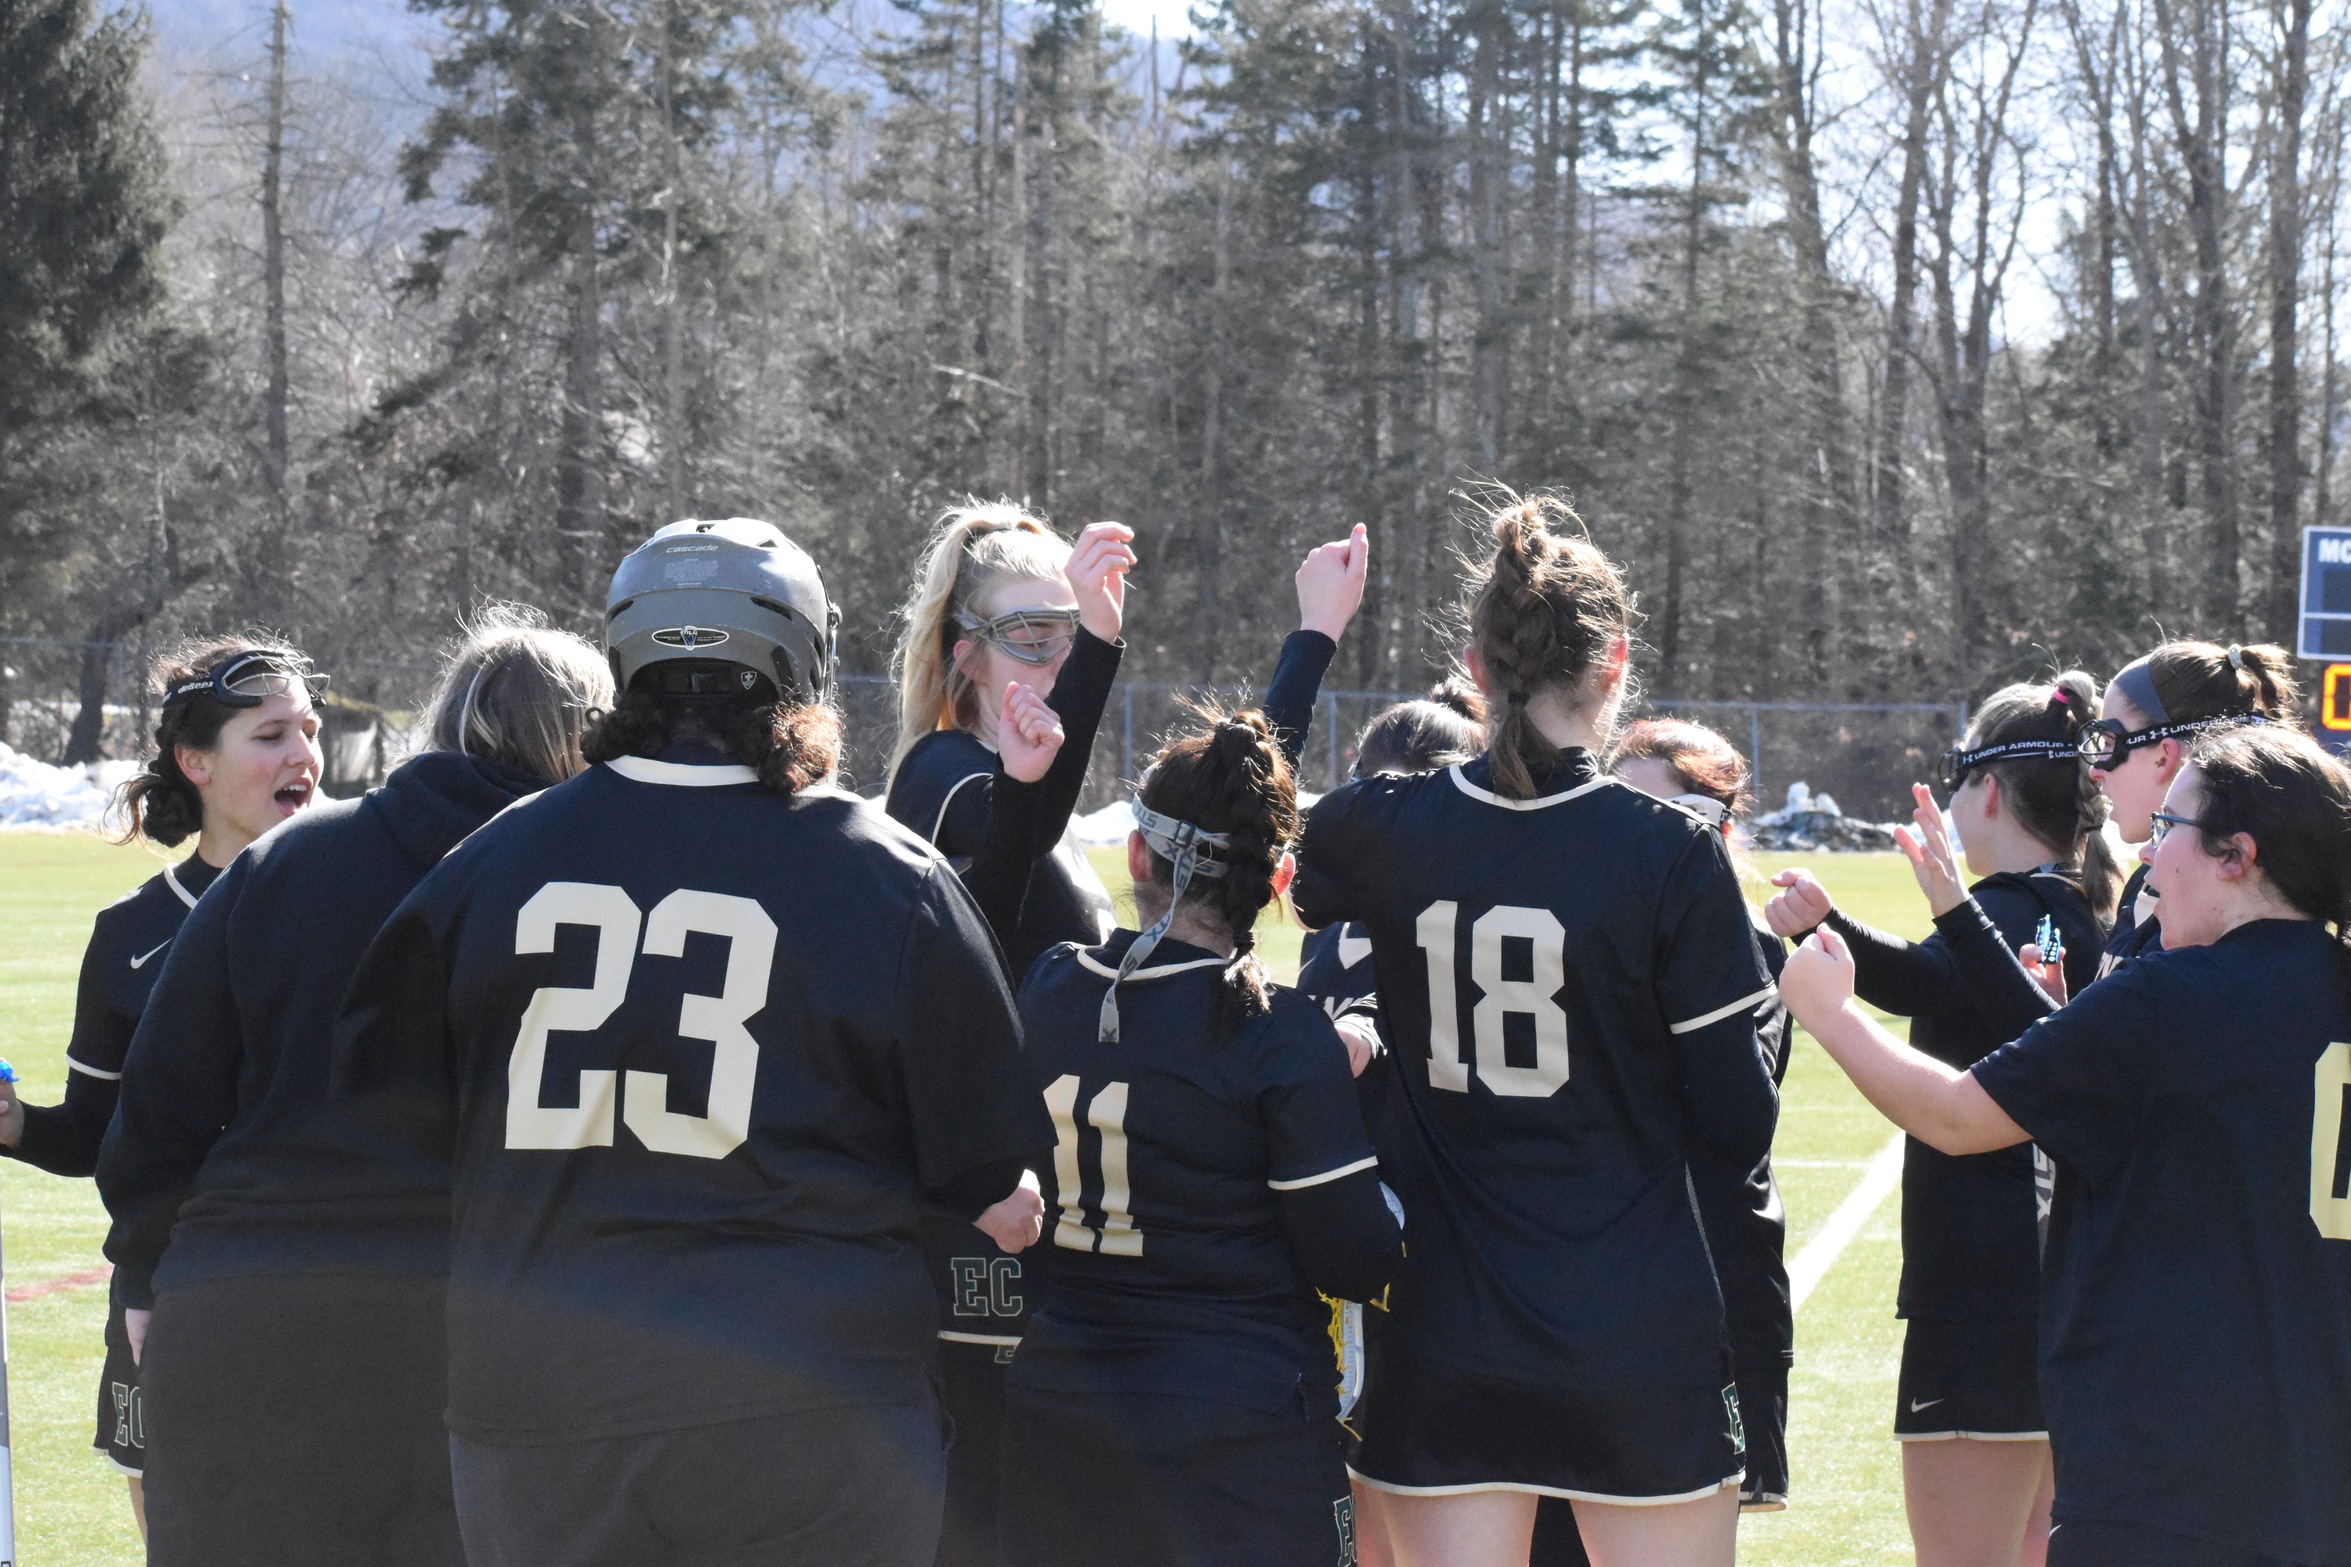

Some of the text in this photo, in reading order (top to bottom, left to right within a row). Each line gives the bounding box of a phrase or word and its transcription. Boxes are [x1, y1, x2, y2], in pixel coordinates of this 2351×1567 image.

[1974, 744, 2006, 760] UNDER
[504, 881, 779, 1161] 23
[1415, 899, 1571, 1098] 18
[1042, 1073, 1144, 1257] 11
[950, 1257, 1024, 1317] EC
